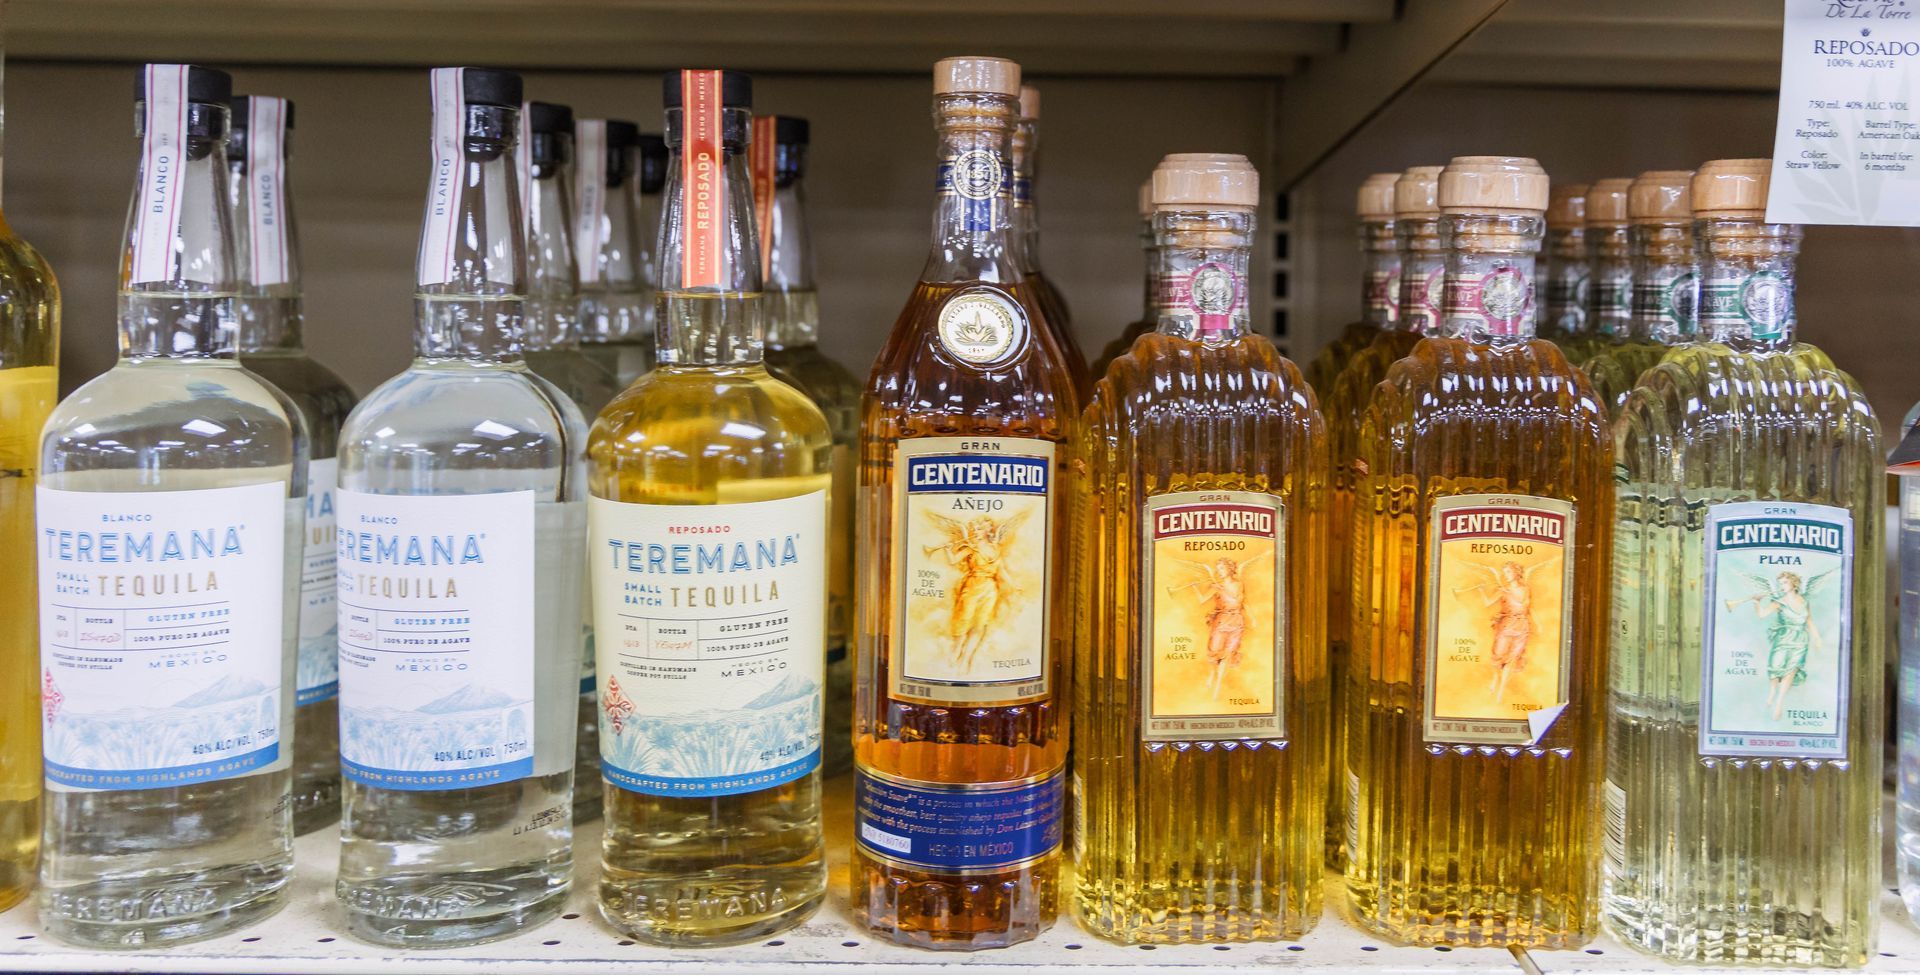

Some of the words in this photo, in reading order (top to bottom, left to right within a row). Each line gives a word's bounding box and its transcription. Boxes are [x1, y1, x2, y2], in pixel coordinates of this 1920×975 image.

[1825, 3, 1845, 19] De
[1849, 3, 1871, 19] La
[1875, 3, 1912, 20] Torre
[1813, 39, 1920, 57] REPOSADO
[1826, 58, 1855, 68] 100%
[1858, 59, 1896, 69] AGAVE
[699, 102, 705, 114] EN
[1808, 100, 1825, 109] 750
[1844, 101, 1863, 110] 40%
[1865, 120, 1891, 129] Barrel
[1795, 129, 1839, 140] Reposado
[1857, 131, 1901, 140] American
[1859, 151, 1870, 160] In
[1871, 151, 1896, 161] barrel
[1784, 160, 1810, 169] Straw
[1811, 160, 1842, 170] Yellow
[1864, 162, 1871, 171] 6
[1871, 163, 1907, 172] months
[153, 155, 170, 214] BLANCO
[435, 158, 451, 216] BLANCO
[697, 151, 710, 230] REPOSADO
[261, 174, 273, 226] BLANCO
[960, 441, 1001, 451] GRAN
[911, 463, 1045, 488] CENTENARIO
[1200, 494, 1231, 502] GRAN
[1487, 498, 1520, 506] GRAN
[951, 496, 1004, 512] AÑEJO
[1764, 507, 1797, 515] GRAN
[101, 513, 153, 523] BLANCO
[360, 514, 399, 525] BLANCO
[1158, 510, 1272, 534] CENTENARIO
[668, 525, 731, 535] REPOSADO
[1445, 513, 1561, 540] CENTENARIO
[1720, 523, 1841, 549] CENTENARIO
[336, 527, 484, 566] EREMANA
[1184, 541, 1246, 552] REPOSADO
[1470, 543, 1534, 555] REPOSADO
[1759, 554, 1803, 565] PLATA
[55, 572, 89, 583] SMALL
[916, 569, 941, 581] 100%
[55, 583, 90, 595] BATCH
[97, 570, 219, 597] TEQUILA
[357, 573, 458, 599] TEQUILA
[624, 582, 662, 595] SMALL
[921, 579, 936, 589] DE
[670, 580, 780, 608] TEQUILA
[911, 588, 946, 599] AGAVE
[624, 594, 663, 607] BATCH
[147, 610, 196, 623] GLUTEN
[201, 608, 231, 619] FREE
[394, 617, 437, 626] GLUTEN
[441, 617, 471, 625] FREE
[719, 621, 762, 634] GLUTEN
[765, 616, 789, 628] FREE
[133, 634, 156, 643] 100%
[159, 632, 184, 642] PURO
[185, 631, 199, 640] DE
[200, 628, 231, 639] AGAVE
[658, 627, 688, 635] BOTTLE
[403, 638, 425, 646] PURO
[427, 637, 440, 645] DE
[441, 637, 471, 645] AGAVE
[706, 645, 728, 653] 100%
[730, 642, 751, 652] PURO
[753, 640, 765, 649] DE
[766, 635, 789, 646] AGAVE
[1169, 636, 1193, 644] 100%
[1453, 638, 1477, 646] 100%
[1174, 644, 1188, 652] DE
[1458, 646, 1472, 654] DE
[1165, 652, 1197, 661] AGAVE
[1731, 651, 1754, 659] 100%
[148, 654, 229, 669] MEXICO
[394, 662, 469, 672] MEXICO
[992, 658, 1032, 670] TEQUILA
[1735, 659, 1749, 667] DE
[658, 665, 698, 673] HANDMADE
[720, 661, 788, 679] MEXICO
[1724, 667, 1758, 676] AGAVE
[1228, 698, 1261, 706] TEQUILA
[1787, 709, 1828, 720] TEQUILA
[193, 741, 213, 755] 40%
[433, 749, 454, 762] 40%
[456, 744, 497, 761] ALC/VOL
[99, 776, 131, 784] FROM
[137, 767, 213, 784] HIGHLANDS
[219, 757, 256, 772] AGAVE
[386, 774, 454, 785] HIGHLANDS
[459, 769, 501, 782] AGAVE
[673, 781, 706, 791] FROM
[711, 774, 776, 790] HIGHLANDS
[896, 819, 909, 830] the
[909, 823, 937, 835] process
[996, 823, 1014, 834] Don
[928, 843, 960, 857] HECHO
[963, 844, 977, 858] EN
